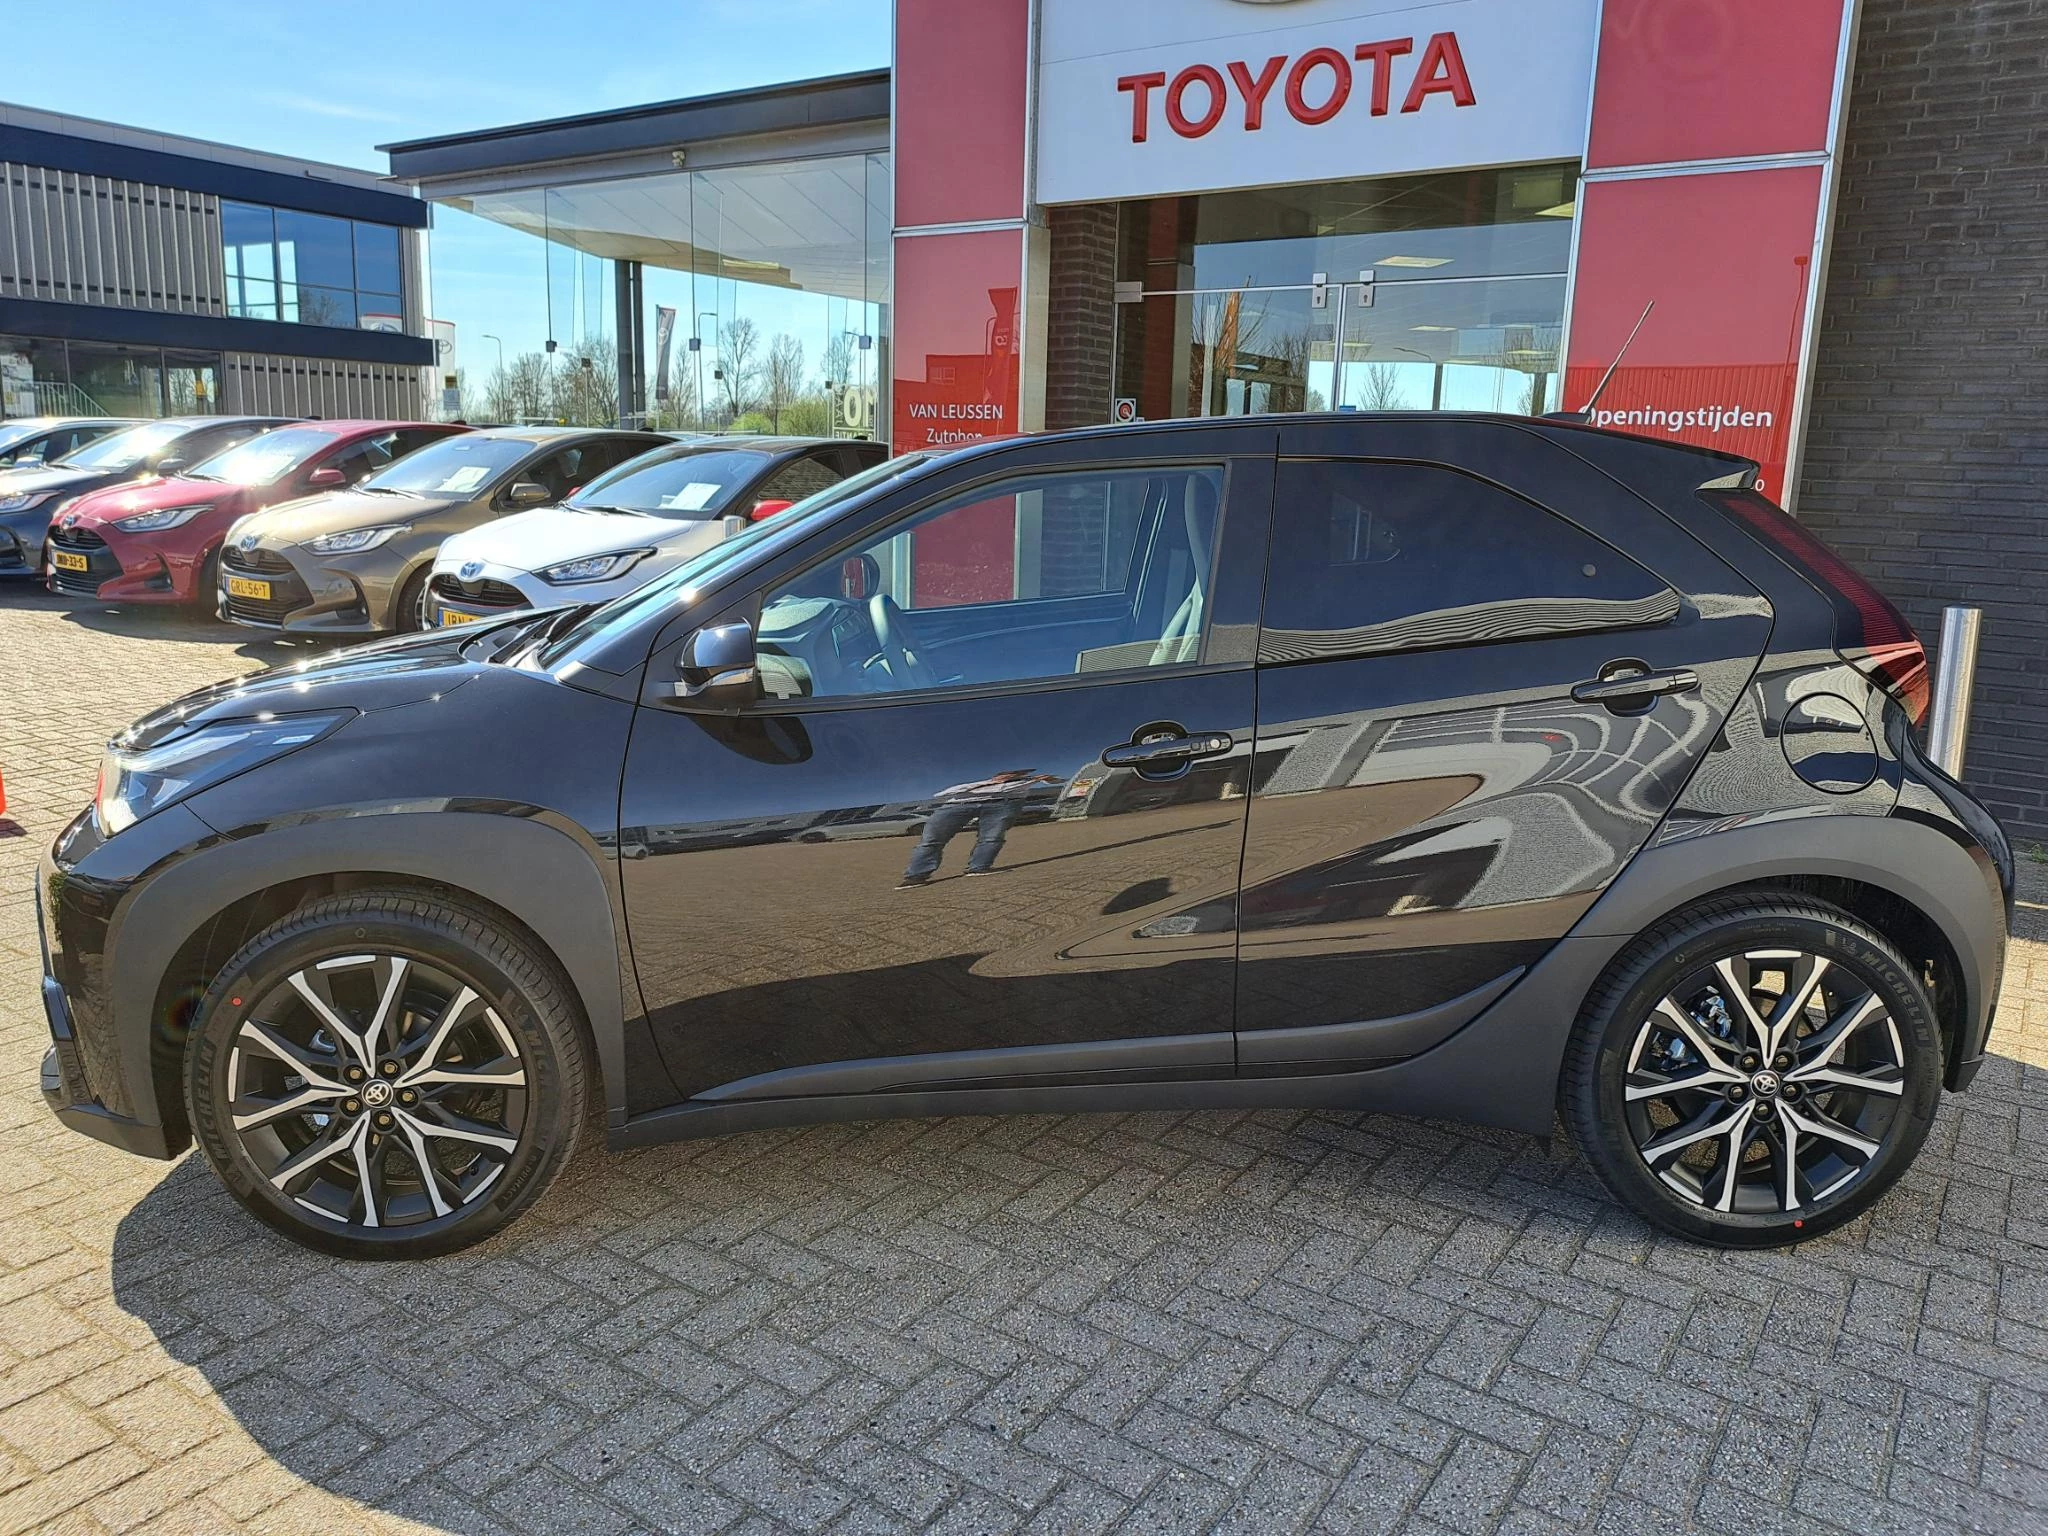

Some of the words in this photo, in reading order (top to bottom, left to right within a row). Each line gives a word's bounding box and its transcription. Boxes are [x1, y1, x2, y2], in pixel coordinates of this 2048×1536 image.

[1117, 31, 1476, 143] TOYOTA
[909, 404, 937, 418] VAN
[941, 404, 1003, 419] LEUSSEN
[1860, 950, 1930, 1041] MICHELIN
[198, 1041, 229, 1161] MICHELIN
